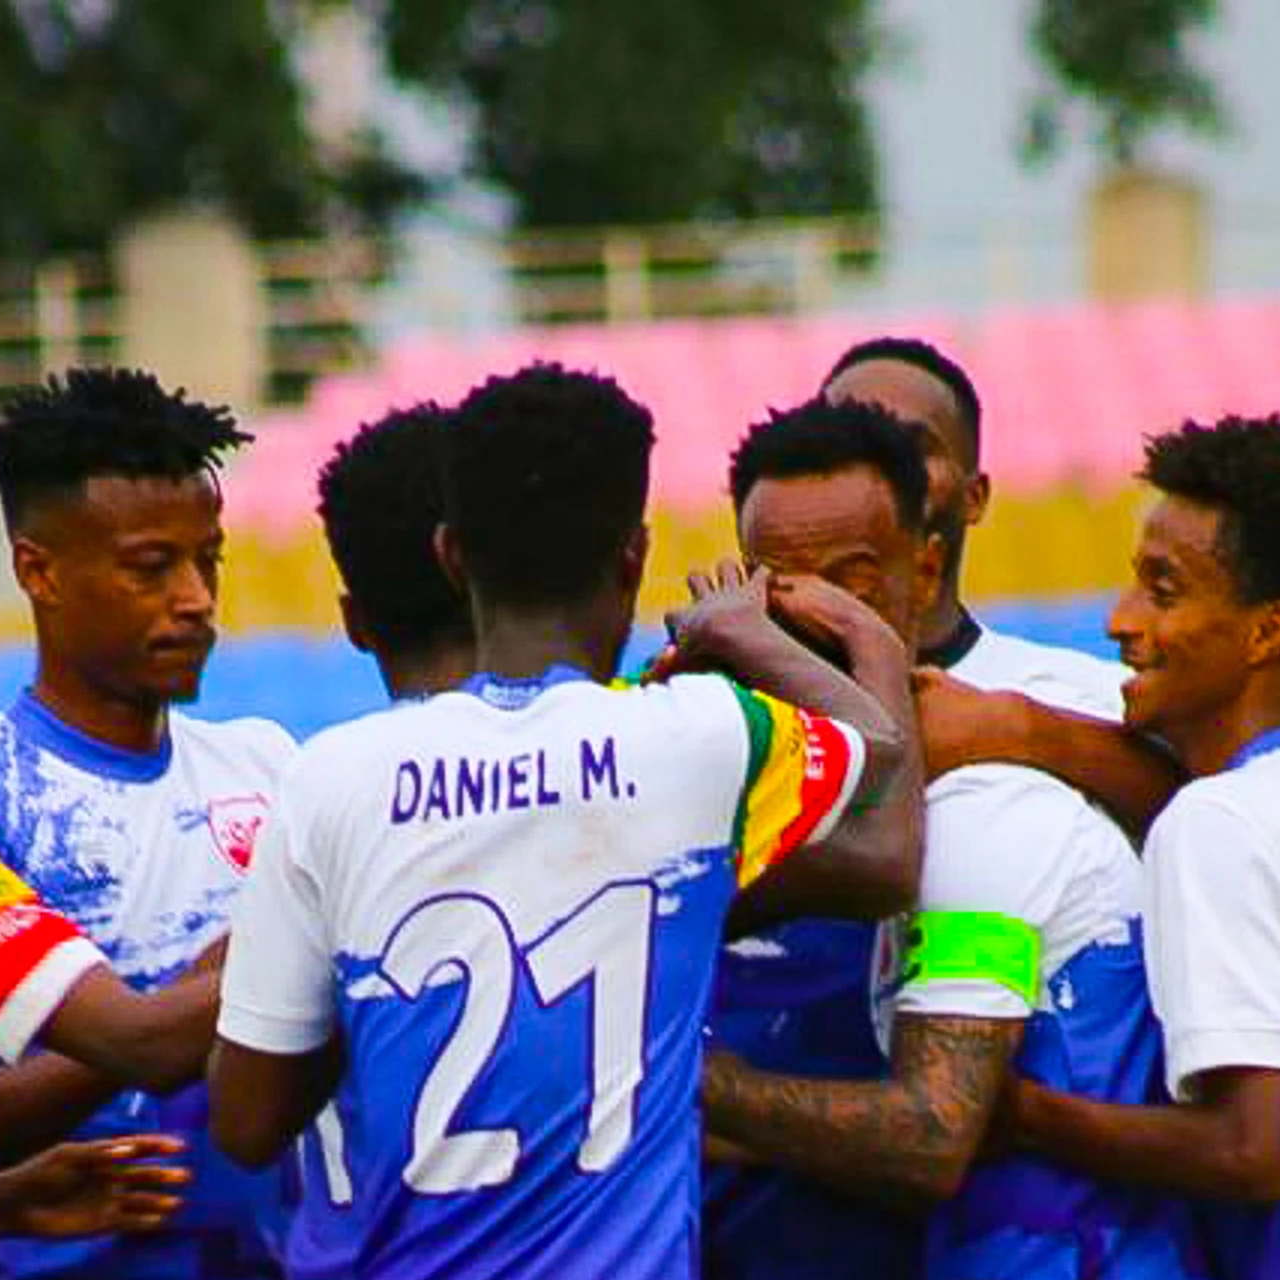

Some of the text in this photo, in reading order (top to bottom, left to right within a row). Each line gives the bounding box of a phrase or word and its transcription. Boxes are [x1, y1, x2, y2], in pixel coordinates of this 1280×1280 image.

[391, 736, 636, 826] DANIEL M.
[377, 877, 660, 1197] 21
